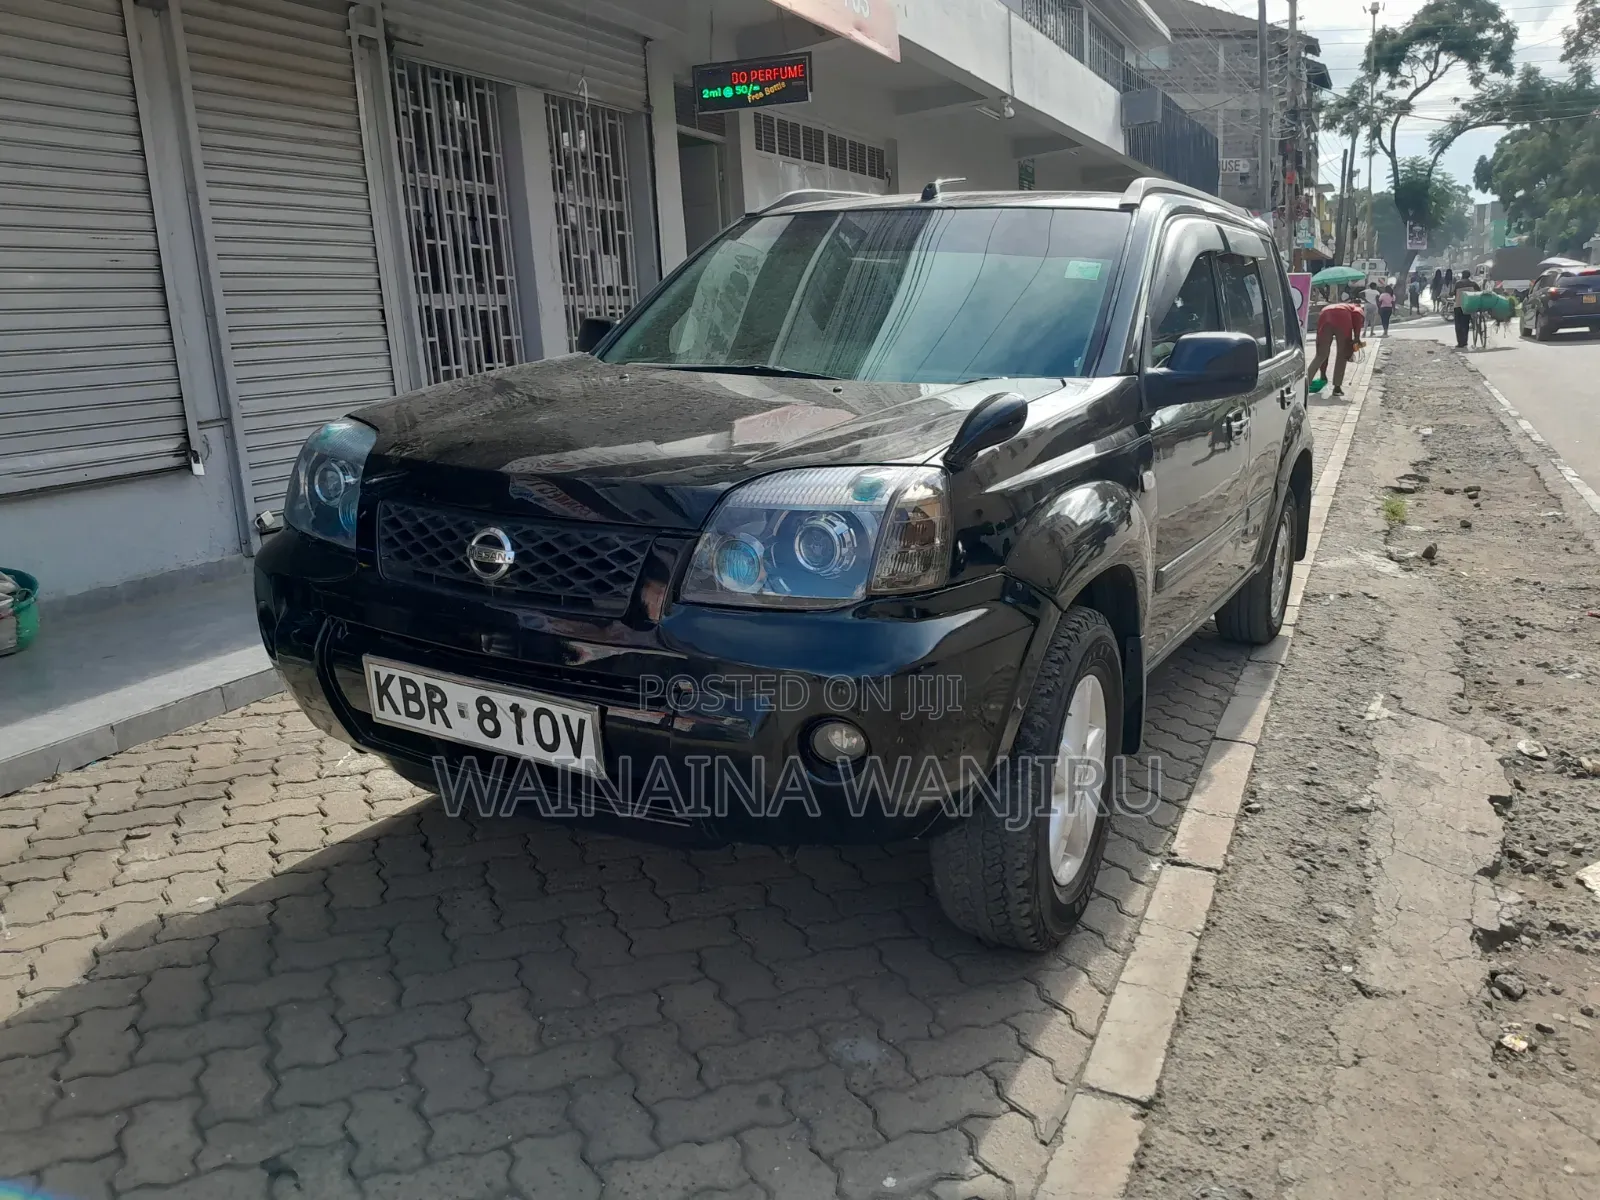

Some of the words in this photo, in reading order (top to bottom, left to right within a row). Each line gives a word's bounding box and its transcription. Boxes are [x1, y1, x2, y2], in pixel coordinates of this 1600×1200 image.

[750, 64, 804, 83] PERFUME
[723, 86, 734, 98] @
[467, 547, 507, 562] NISSAN
[373, 670, 453, 730] KBR
[475, 695, 586, 760] 810V
